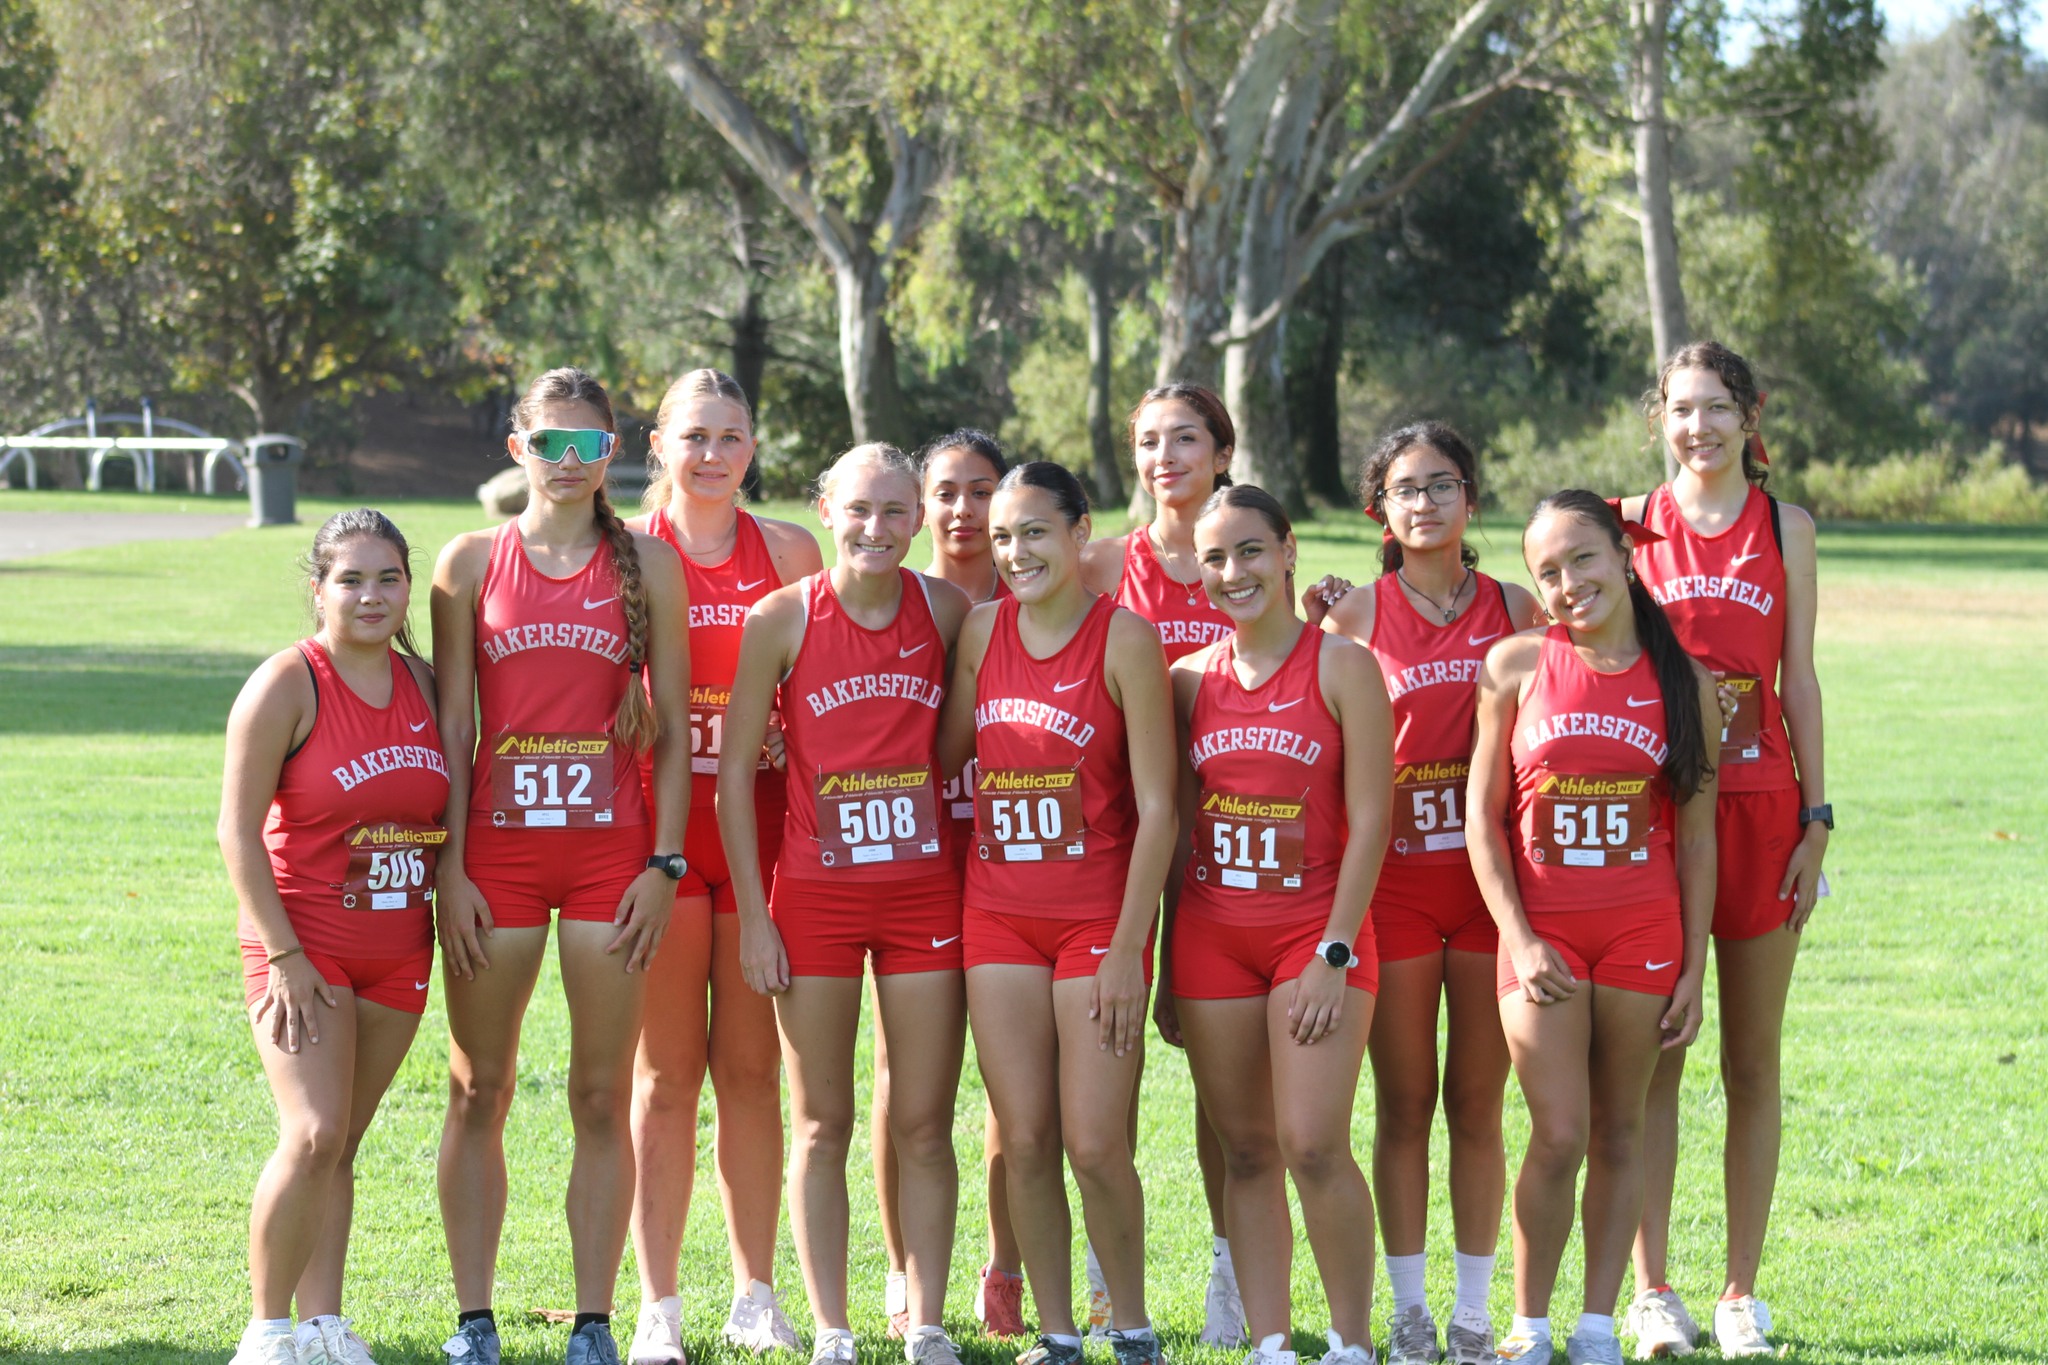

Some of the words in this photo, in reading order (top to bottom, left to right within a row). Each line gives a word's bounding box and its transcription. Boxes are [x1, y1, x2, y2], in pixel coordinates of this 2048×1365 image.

[483, 623, 632, 665] BAKERSFIELD
[806, 673, 944, 717] BAKERSFIELD
[975, 698, 1095, 748] BAKERSFIELD
[1523, 712, 1669, 766] BAKERSFIELD
[581, 743, 604, 752] NET
[514, 763, 592, 806] 512
[902, 775, 923, 784] NET
[1049, 776, 1071, 785] NET
[1620, 783, 1641, 792] NET
[839, 797, 916, 844] 508
[992, 797, 1062, 842] 510
[1273, 807, 1296, 816] NET
[1553, 804, 1628, 846] 515
[425, 833, 444, 842] NET
[1213, 822, 1279, 869] 511
[367, 848, 425, 890] 506
